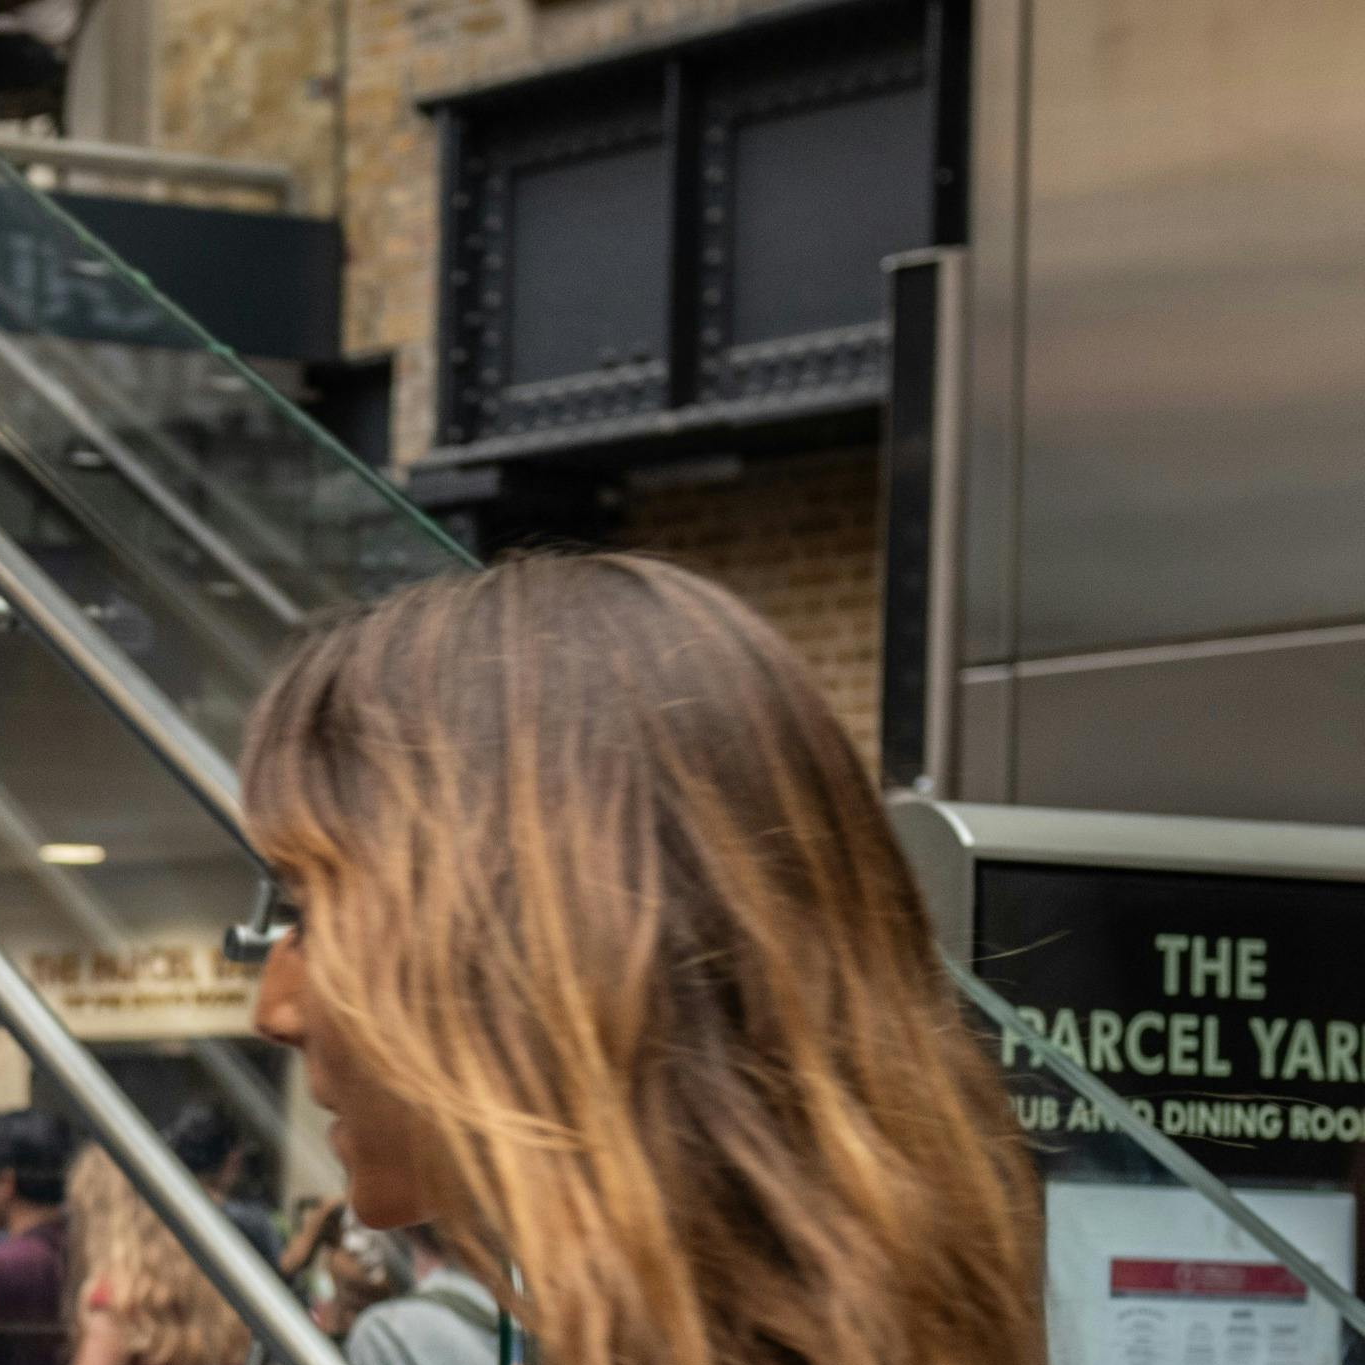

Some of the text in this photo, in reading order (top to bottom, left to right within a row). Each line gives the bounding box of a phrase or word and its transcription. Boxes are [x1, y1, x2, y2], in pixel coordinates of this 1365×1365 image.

[1155, 933, 1268, 1000] THE
[1001, 1005, 1365, 1084] PARCEL YAR
[1011, 1095, 1060, 1131] UB
[1162, 1099, 1283, 1140] DINING
[1288, 1103, 1365, 1144] ROO
